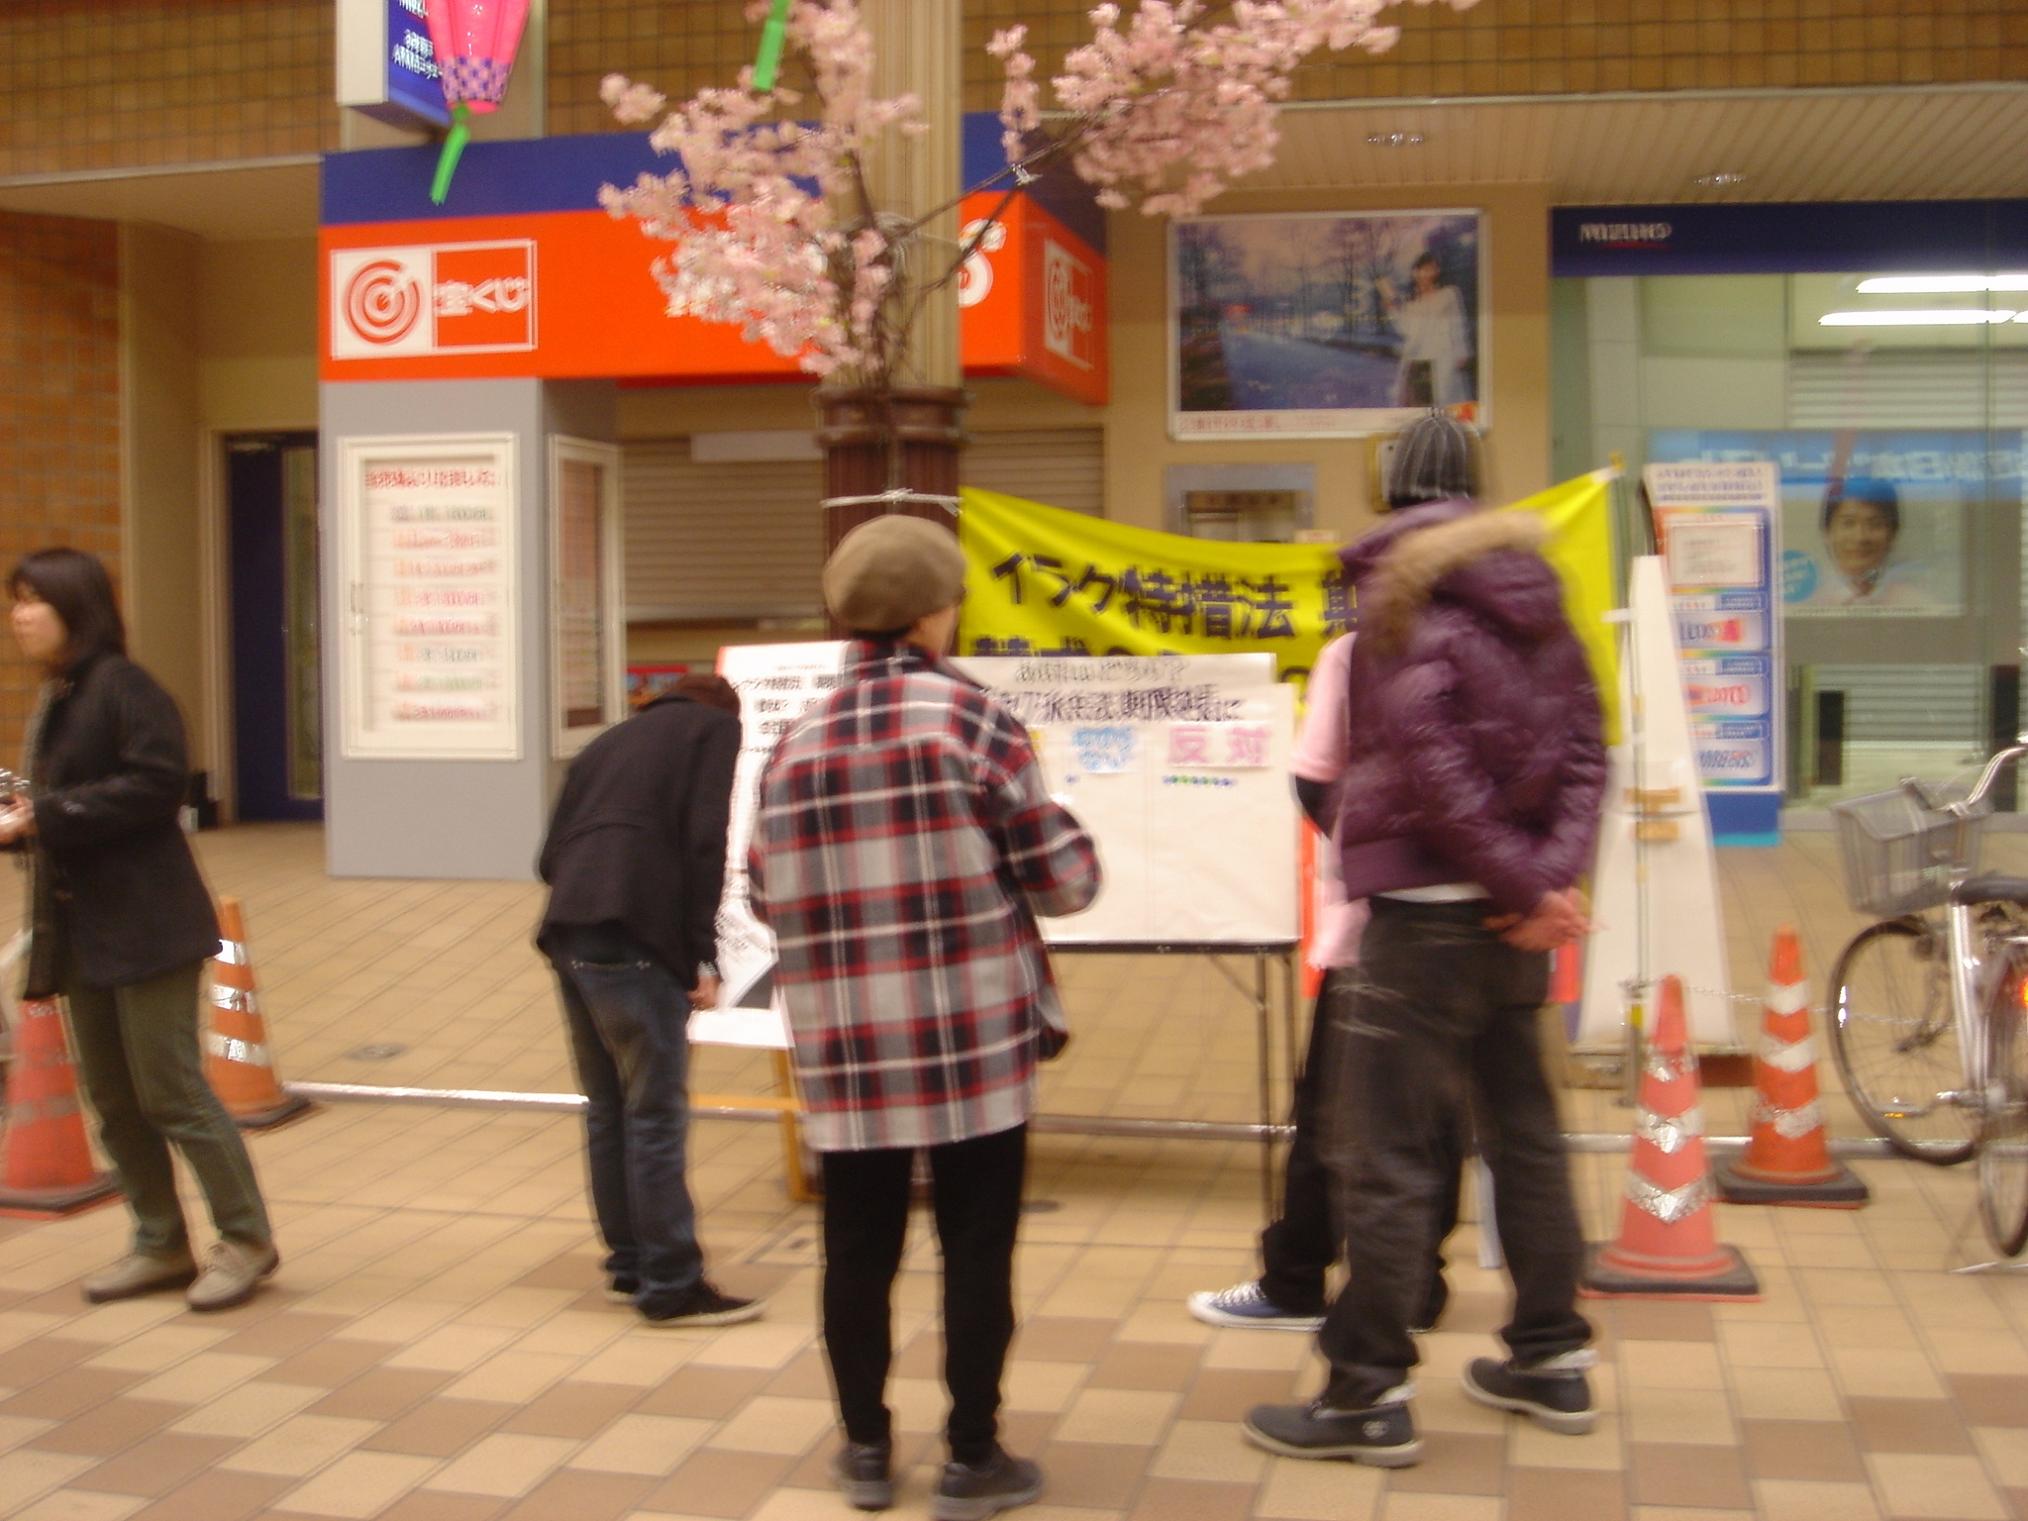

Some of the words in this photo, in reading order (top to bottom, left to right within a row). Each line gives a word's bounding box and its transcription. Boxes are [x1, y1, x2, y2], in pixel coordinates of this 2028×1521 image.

[992, 552, 1294, 640] イラク特措法
[1167, 727, 1271, 766] 反対
